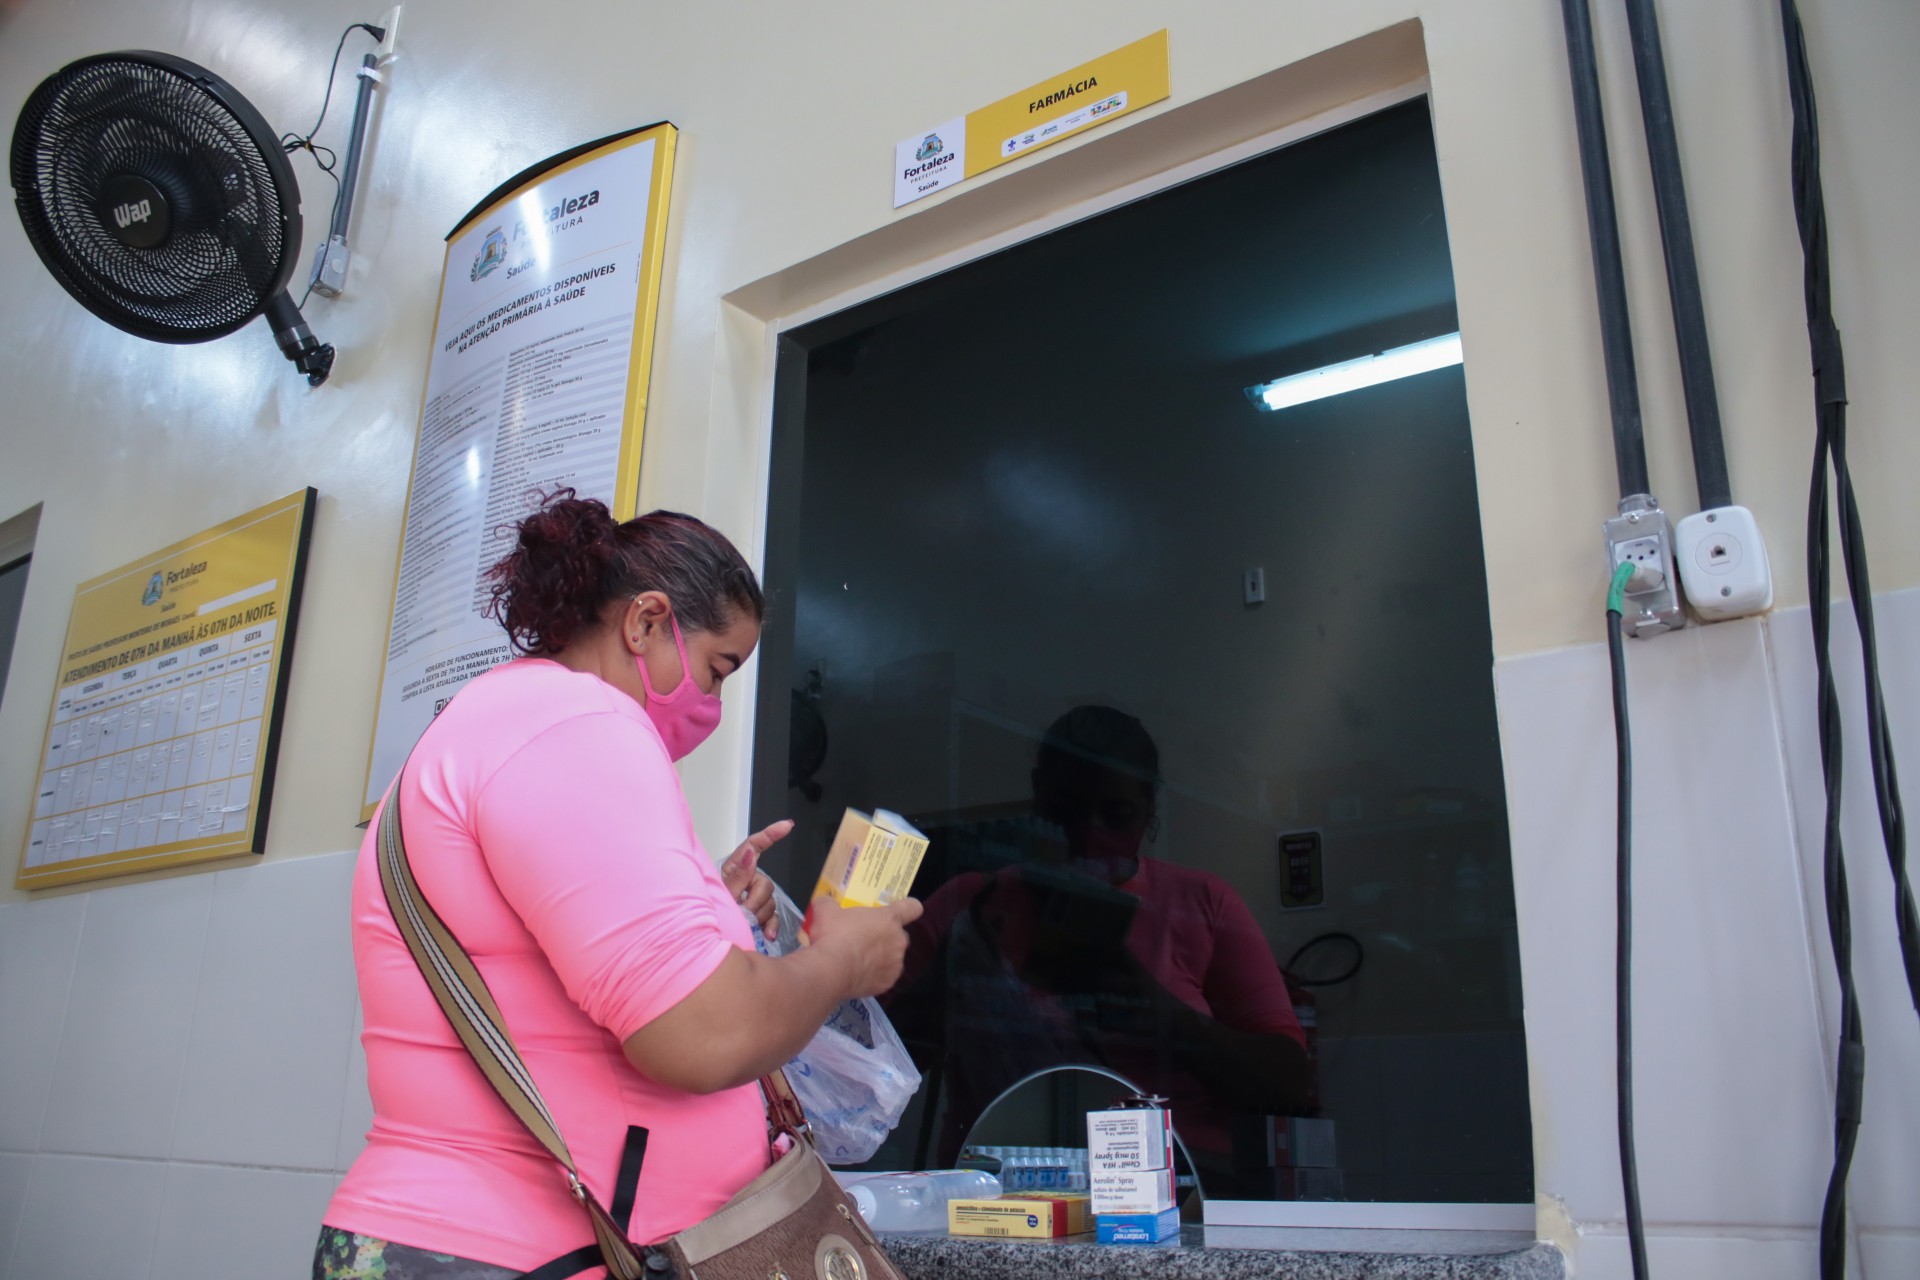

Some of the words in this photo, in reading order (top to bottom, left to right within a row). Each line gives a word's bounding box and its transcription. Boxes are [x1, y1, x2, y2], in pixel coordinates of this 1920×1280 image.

[1029, 77, 1098, 113] FARMÁCIA
[904, 151, 955, 180] Fortaleza
[911, 166, 947, 184] PREFEITURA
[918, 179, 939, 193] Saúde
[114, 199, 152, 228] Wap
[513, 190, 600, 241] Faleza
[521, 216, 583, 248] PITURA
[506, 257, 537, 279] Saúde
[445, 336, 459, 352] VEJA
[459, 323, 476, 343] AQUI
[476, 318, 486, 330] OS
[487, 284, 552, 325] MEDICAMENTOS
[554, 263, 616, 292] DISPONÍVEIS
[458, 344, 468, 355] NA
[469, 321, 501, 350] ATENÇÃO
[502, 303, 543, 330] PRIMÁRIA
[545, 296, 552, 309] À
[554, 286, 586, 307] SAÚDE
[166, 561, 208, 585] Fortaleza
[161, 602, 177, 613] Saúde
[63, 655, 117, 684] ATENDIMENTO
[118, 650, 131, 665] DE
[131, 645, 147, 662] 07H
[147, 640, 160, 656] DA
[162, 627, 195, 651] MANHÃ
[196, 623, 209, 640] ÀS
[210, 620, 228, 636] 07H
[229, 614, 244, 629] DA
[245, 601, 277, 621] NOITE.
[244, 630, 262, 643] SEXTA
[199, 643, 219, 657] QUINTA
[425, 660, 447, 674] HORÁRIO
[447, 657, 455, 667] DE
[455, 645, 509, 664] FUNCIONAMENTO:
[158, 656, 178, 670] QUARTA
[121, 669, 137, 680] TERÇA
[402, 679, 421, 693] SEGUNDA
[426, 672, 440, 683] SEXTA
[440, 669, 448, 678] DE
[448, 666, 456, 675] 7H
[456, 664, 465, 673] DA
[466, 657, 490, 671] MANHÃ
[491, 655, 500, 664] ÀS
[502, 654, 511, 663] 7H
[82, 681, 104, 695] SEGUNDA
[401, 690, 418, 702] CONFIRA
[423, 683, 435, 693] LISTA
[436, 673, 468, 688] ATUALIZADA
[470, 667, 493, 679] TAMBÉ
[1094, 1151, 1113, 1160] Spray
[1102, 1161, 1116, 1169] HFA
[1115, 1151, 1130, 1159] mcg
[1130, 1152, 1140, 1160] 50
[1118, 1177, 1134, 1185] Spray
